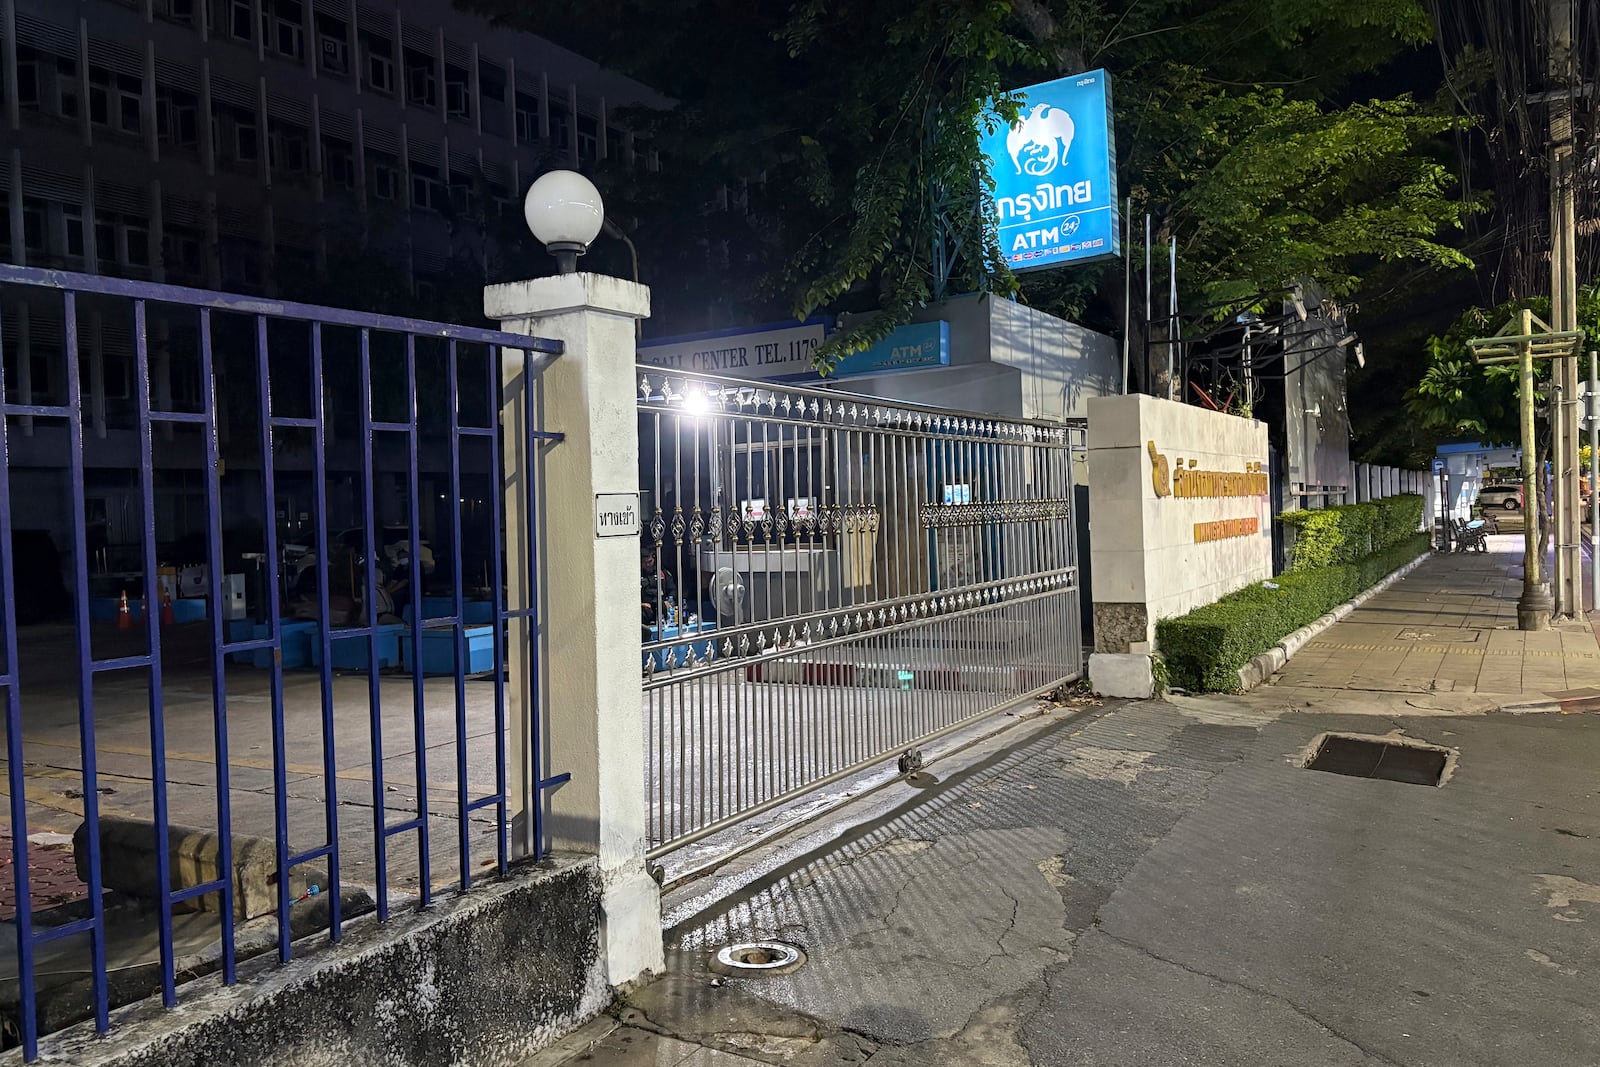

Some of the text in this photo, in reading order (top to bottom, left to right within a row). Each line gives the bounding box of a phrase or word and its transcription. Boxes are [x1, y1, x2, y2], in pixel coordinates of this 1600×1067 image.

[998, 180, 1092, 221] กรุงไทย
[1012, 227, 1059, 251] ATM
[691, 346, 749, 371] CENTER
[890, 344, 923, 360] ATM
[599, 505, 635, 526] ทางเข้า
